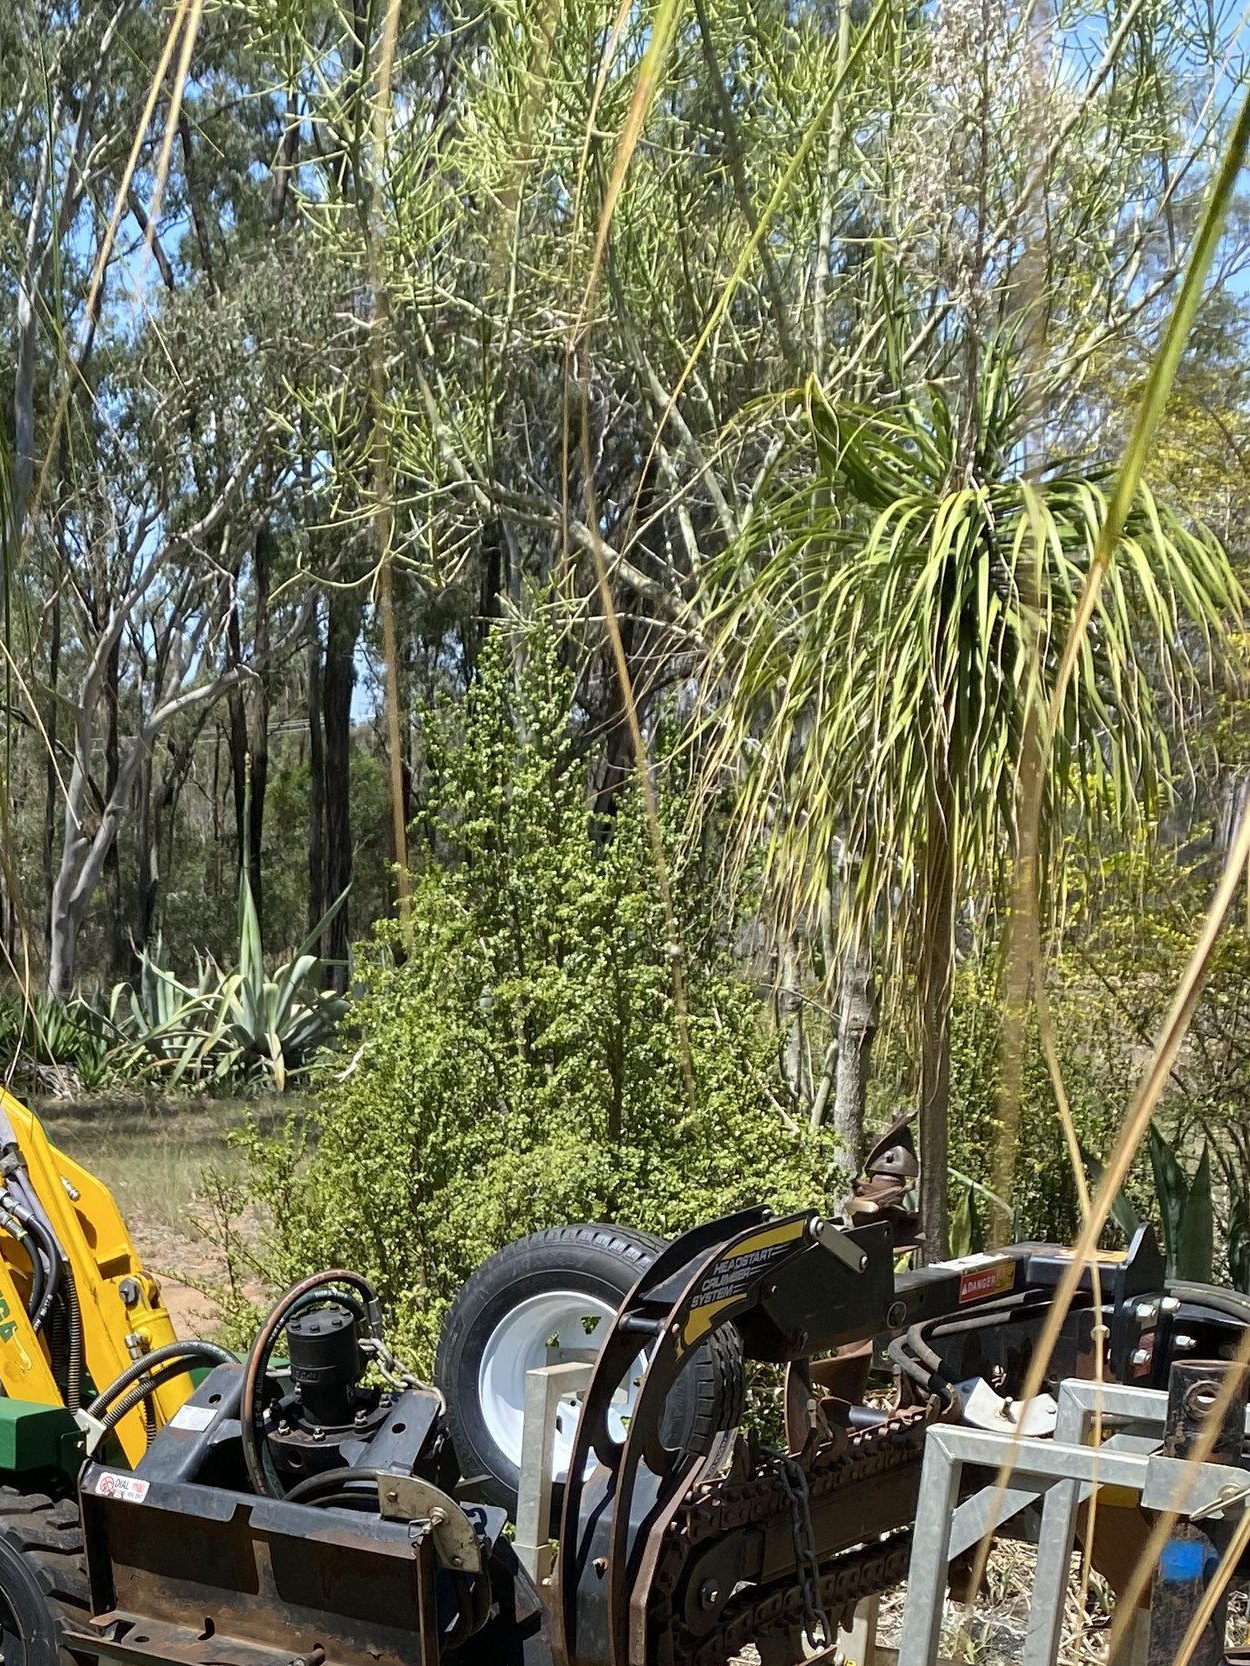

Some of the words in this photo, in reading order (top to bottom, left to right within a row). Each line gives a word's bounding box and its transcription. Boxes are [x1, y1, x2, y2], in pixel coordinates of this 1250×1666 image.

[713, 1248, 773, 1275] HEADSTART
[701, 1267, 751, 1292] CRUMBER
[967, 1275, 996, 1293] DANGER
[691, 1284, 735, 1308] SYSTEM
[114, 1478, 130, 1490] DIAL
